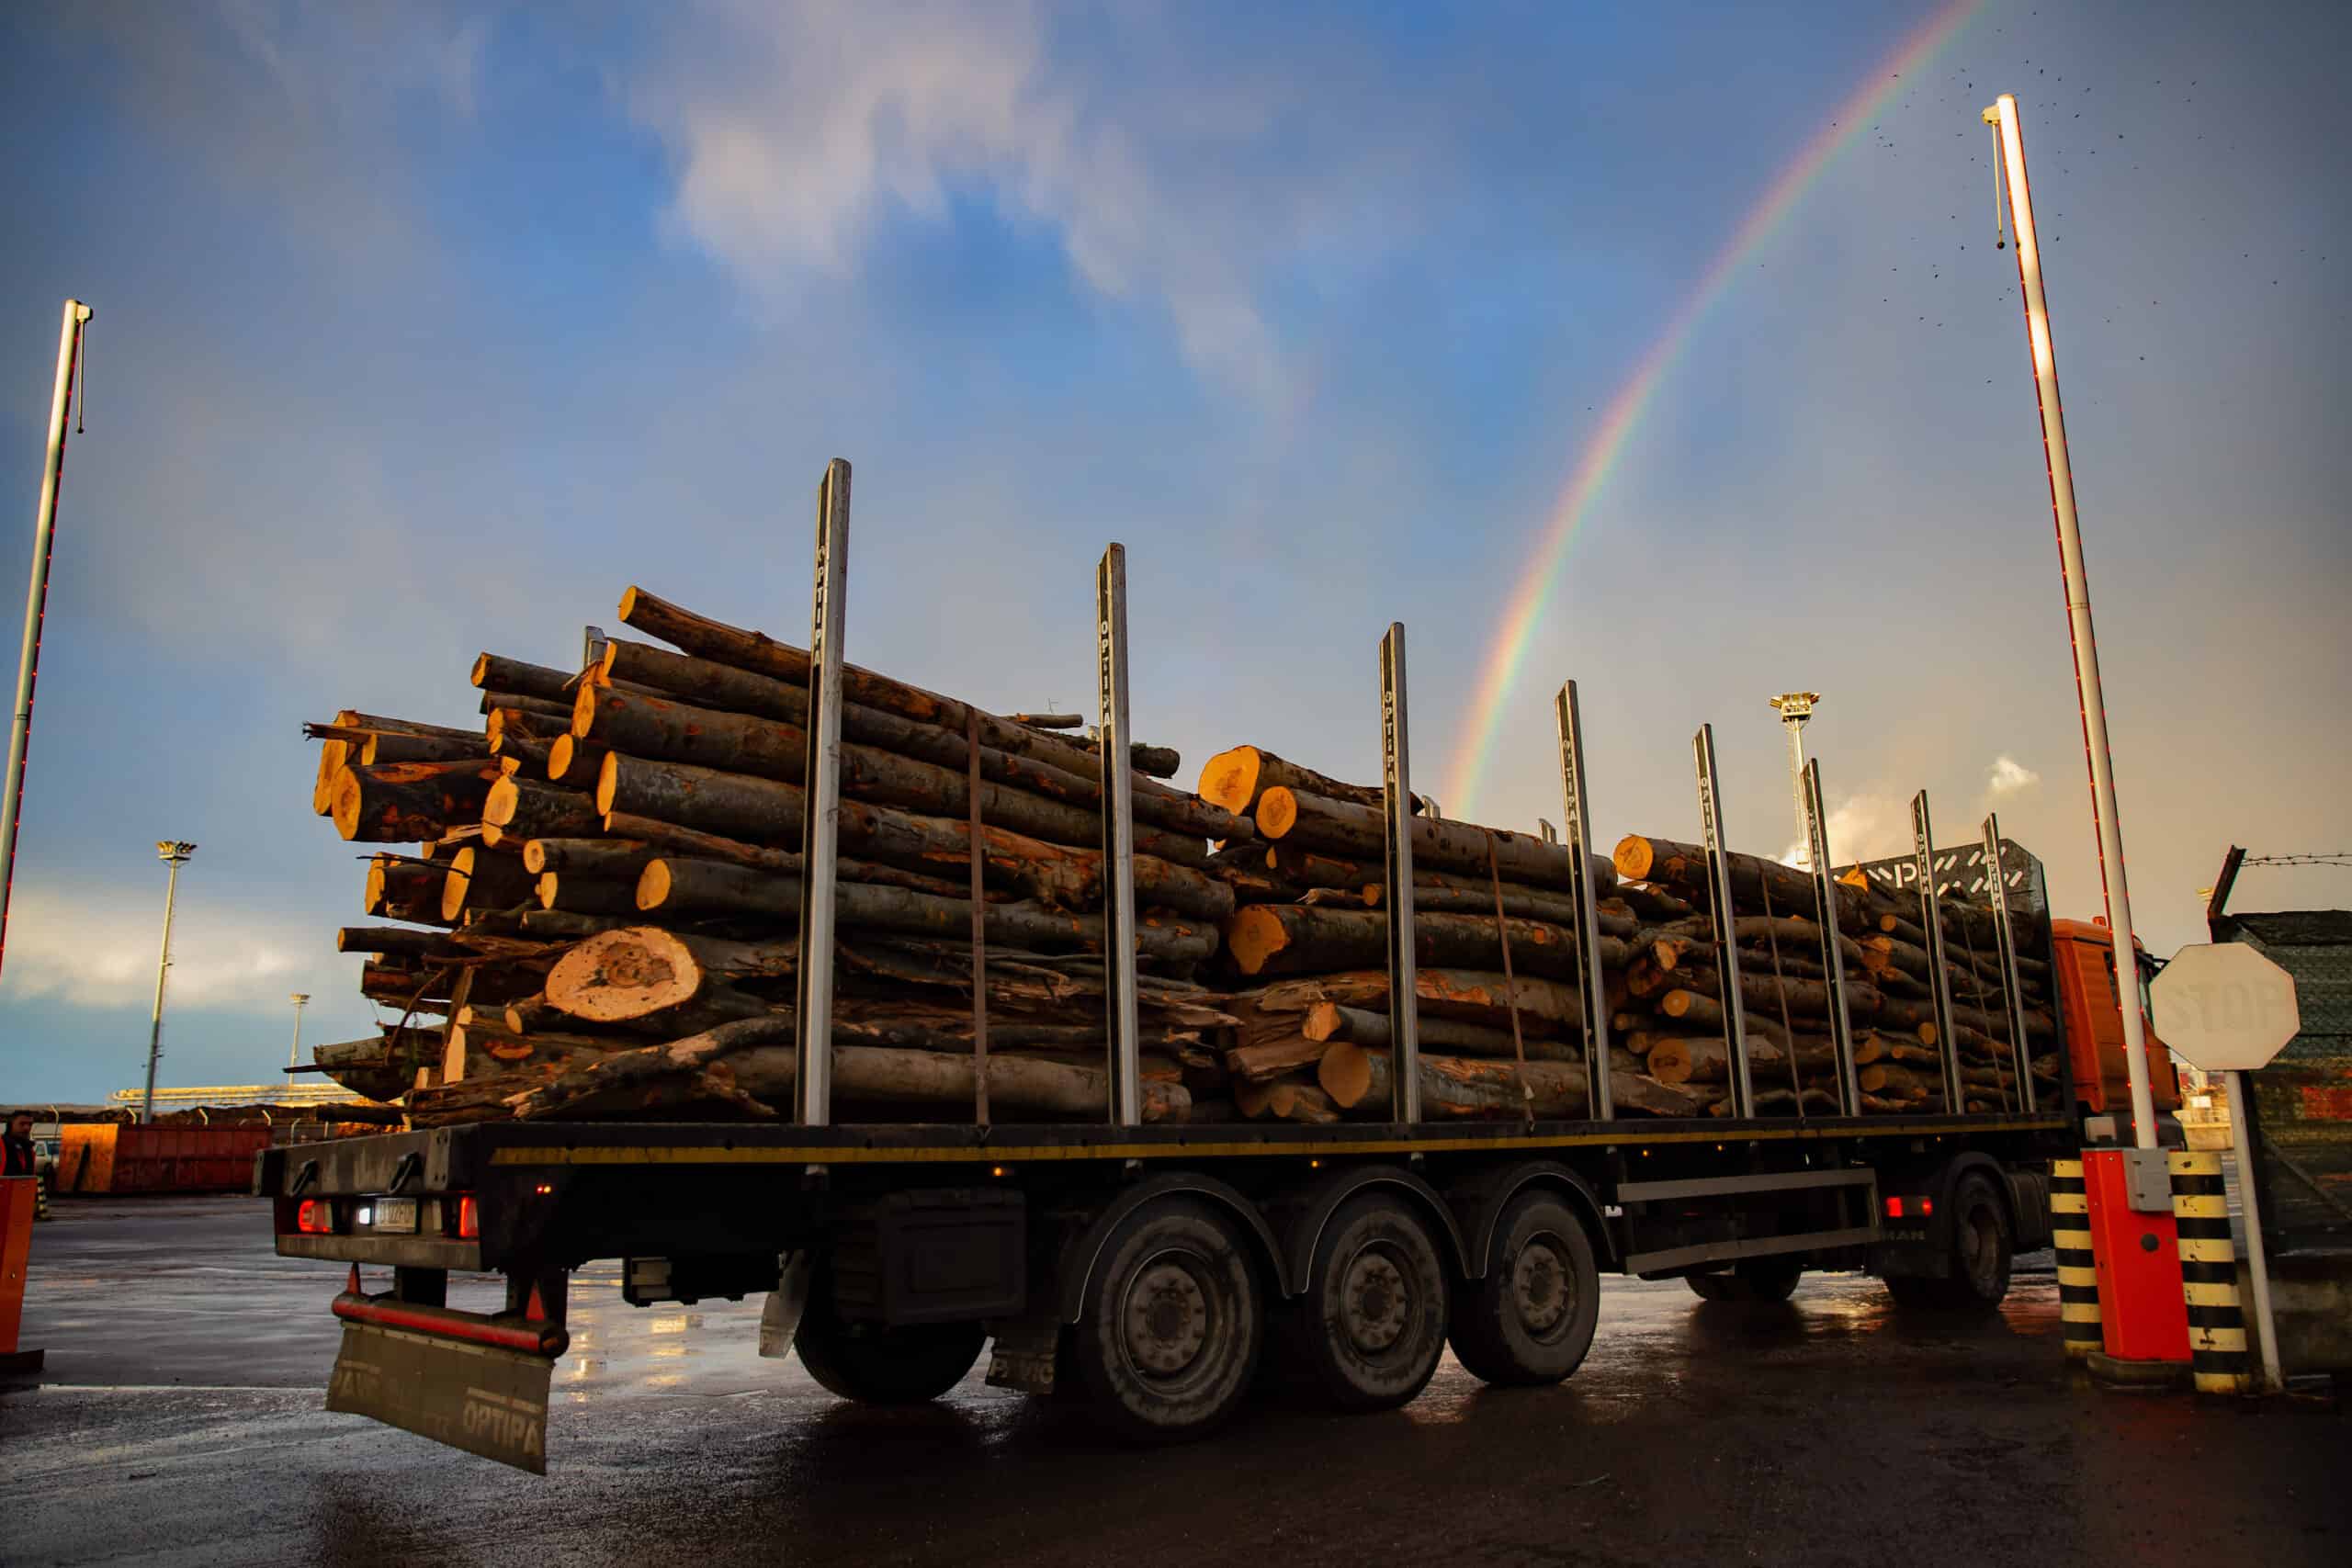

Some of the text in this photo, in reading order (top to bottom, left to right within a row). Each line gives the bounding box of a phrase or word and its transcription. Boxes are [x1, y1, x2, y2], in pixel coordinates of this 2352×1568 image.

[1102, 620, 1112, 727] OPTIPA
[1701, 777, 1715, 852] OPTIPA
[2166, 978, 2280, 1032] STOP
[462, 1398, 544, 1457] OPTIPA
